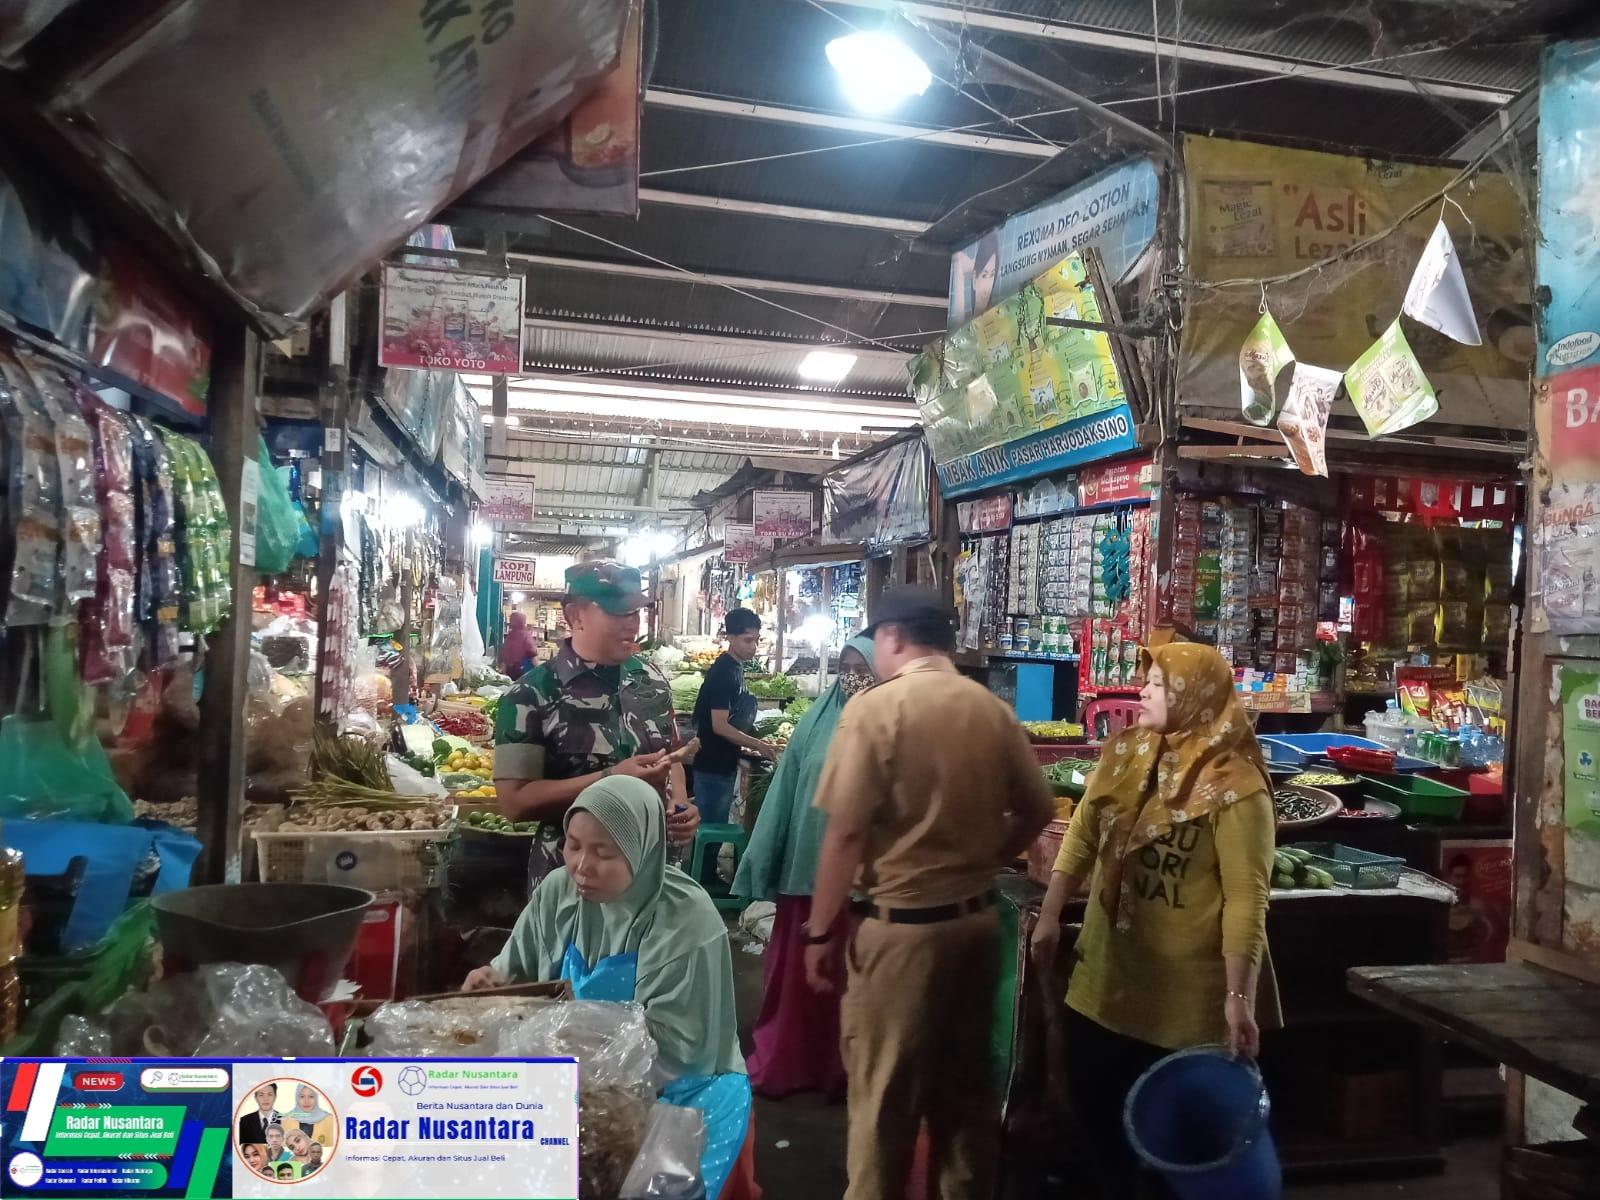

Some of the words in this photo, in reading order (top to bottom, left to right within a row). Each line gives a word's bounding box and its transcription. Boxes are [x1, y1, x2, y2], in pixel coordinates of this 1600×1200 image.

[1071, 225, 1101, 249] SEGAR
[1557, 334, 1593, 353] Indofood
[419, 355, 451, 366] TOKO
[454, 357, 486, 369] YOTO
[943, 460, 974, 488] MBAK
[977, 447, 1010, 477] ANIK
[1011, 442, 1042, 467] PASAR
[1041, 413, 1130, 462] HARJODAKSINO
[500, 561, 529, 571] KOPI
[495, 570, 532, 582] LAMPUNG
[1140, 845, 1191, 880] ORI
